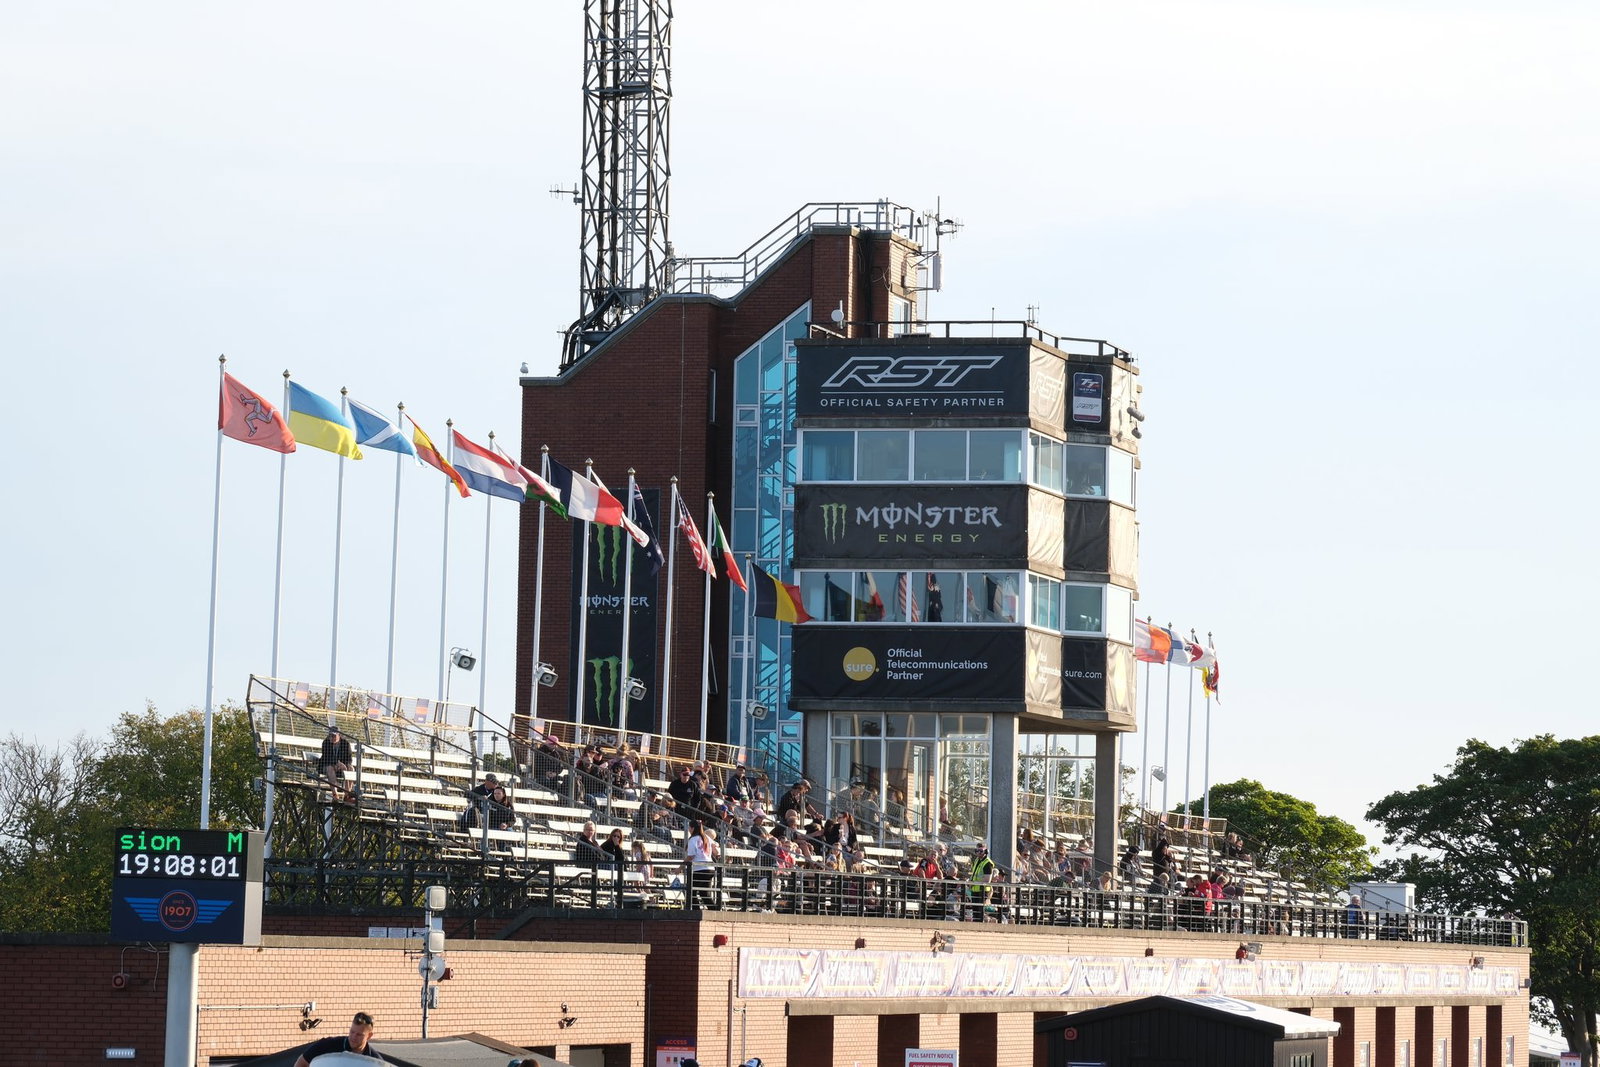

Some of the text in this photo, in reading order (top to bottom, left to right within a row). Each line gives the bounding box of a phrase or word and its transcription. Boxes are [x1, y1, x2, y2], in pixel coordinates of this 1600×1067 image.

[821, 356, 1004, 387] RST
[820, 397, 1005, 407] OFFICIAL SAFETY PARTNER
[855, 502, 1002, 530] MONSTER
[878, 533, 980, 543] ENERGY
[887, 648, 922, 658] Official
[887, 659, 988, 670] Telecommunications
[886, 671, 923, 680] Partner
[1064, 670, 1102, 679] sure.com
[120, 831, 243, 853] sion M
[120, 853, 239, 877] 19:08:01
[164, 906, 191, 917] 1907
